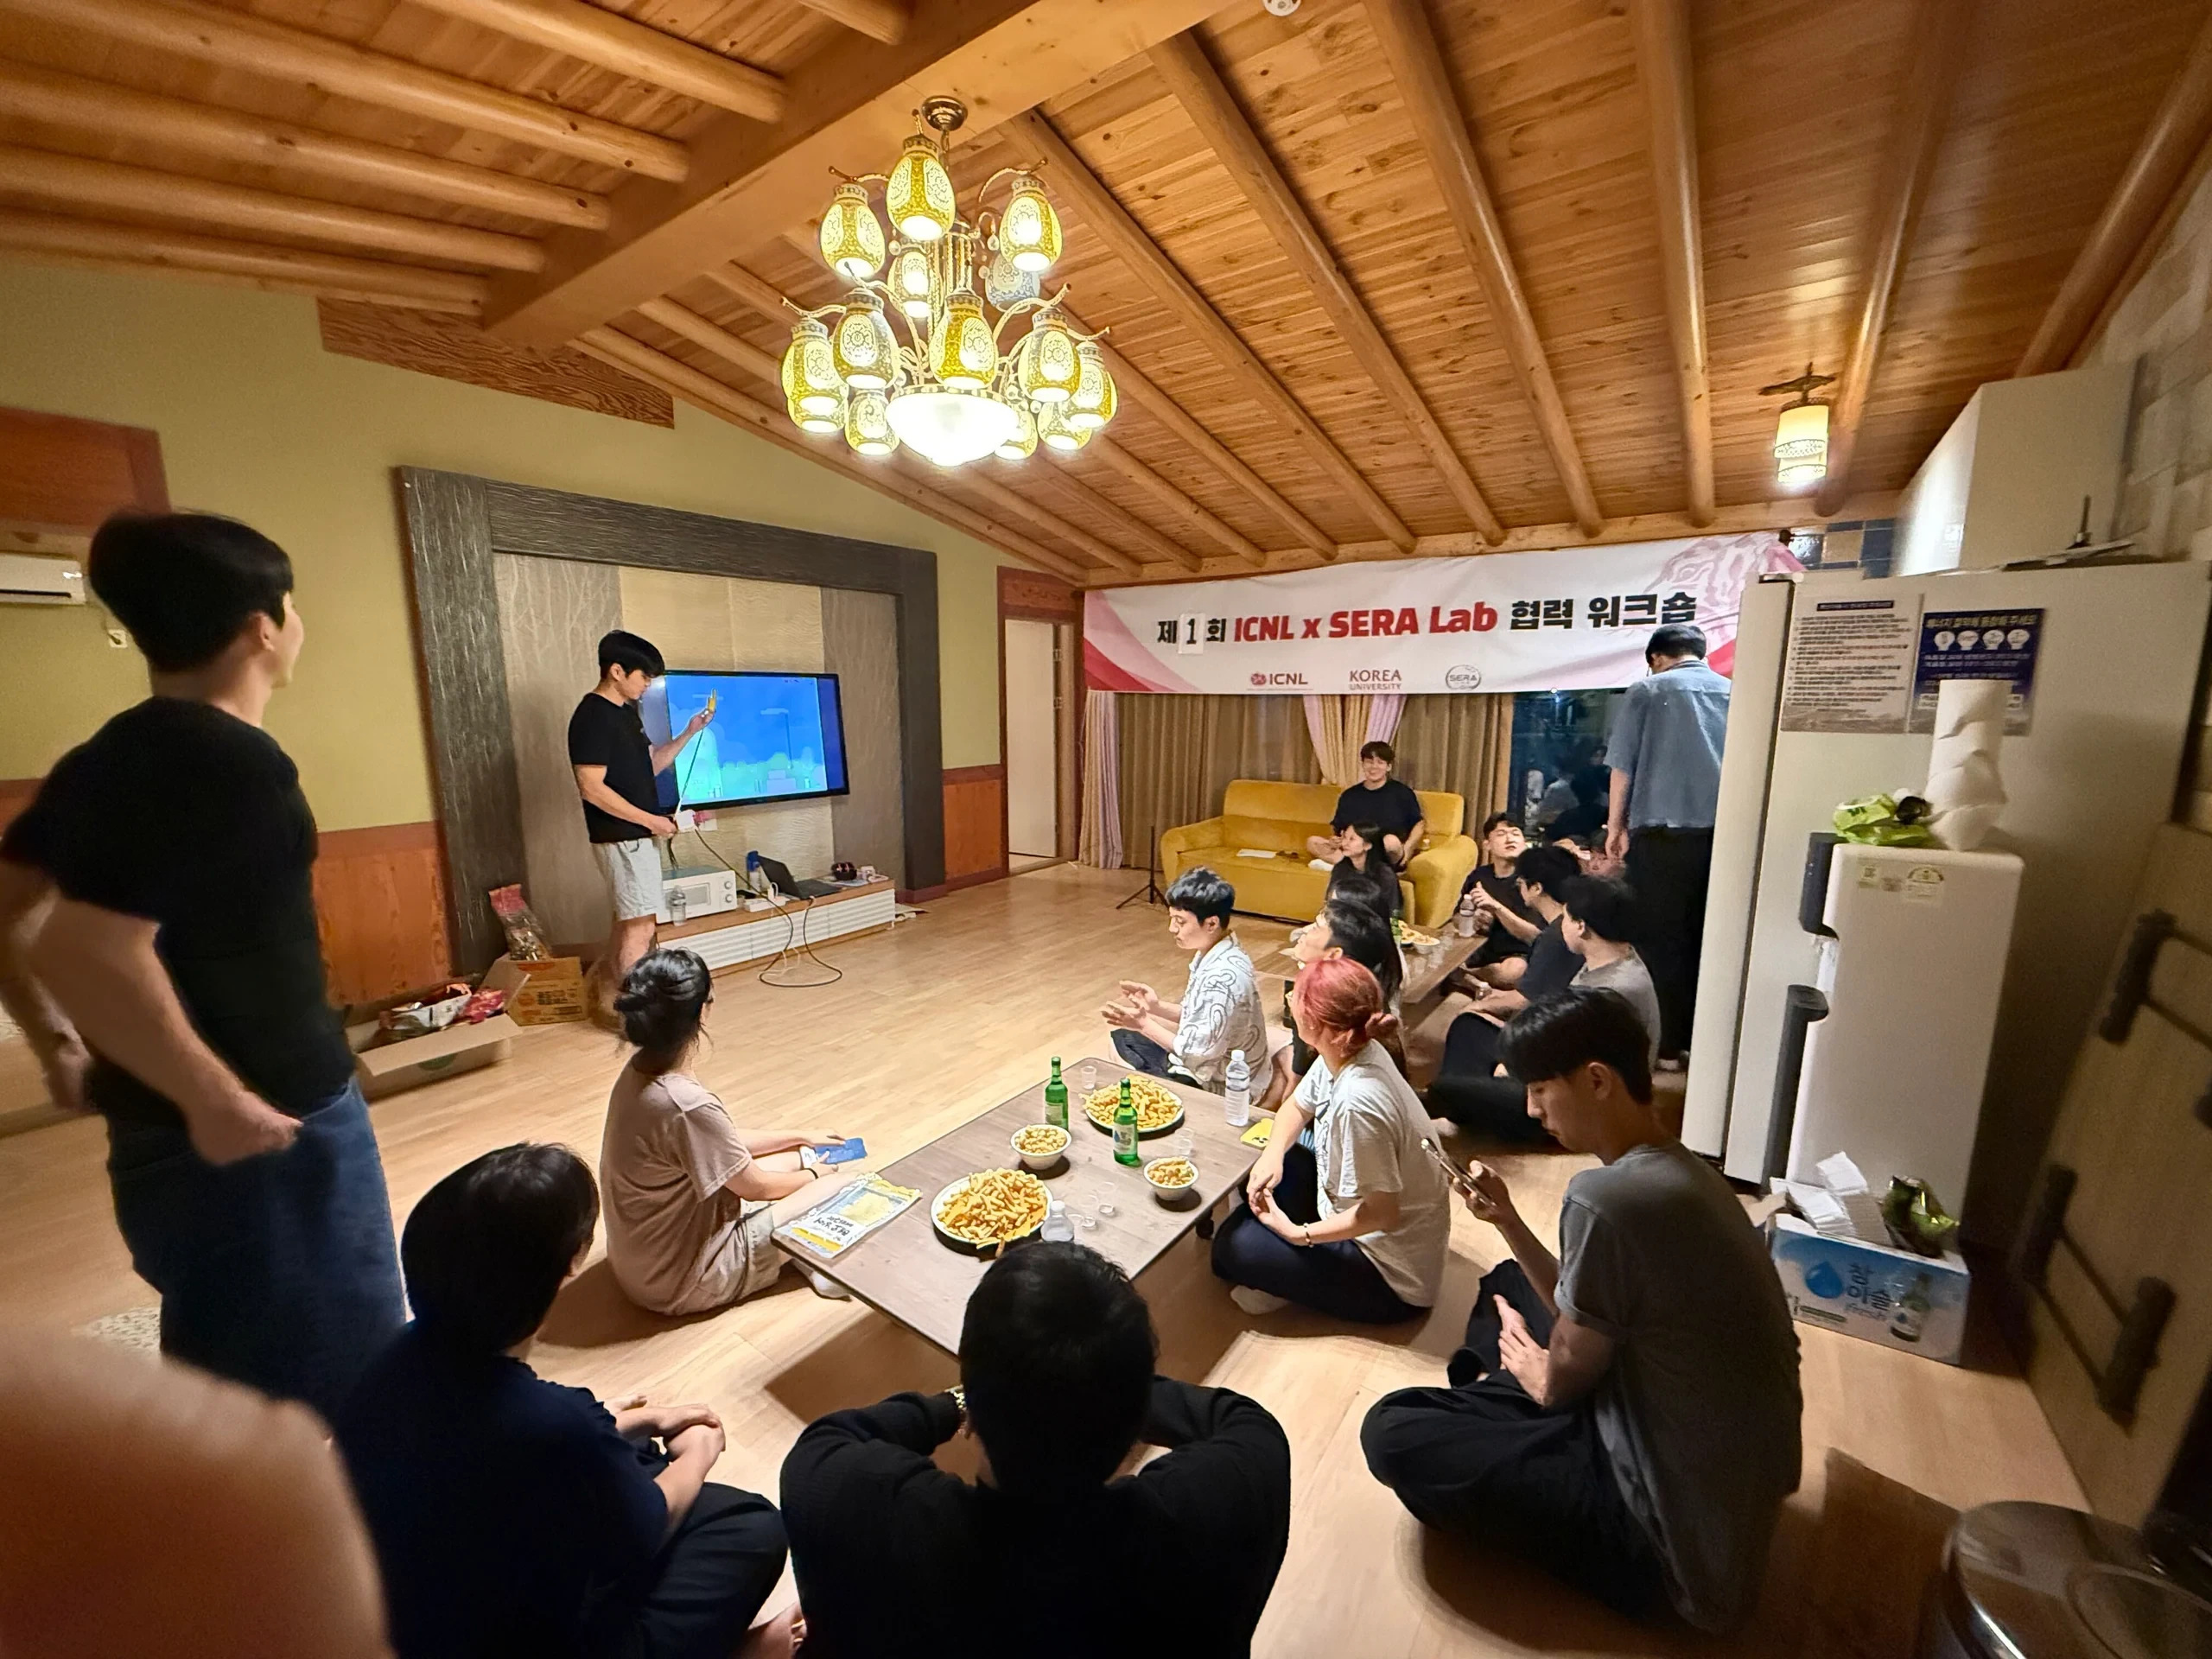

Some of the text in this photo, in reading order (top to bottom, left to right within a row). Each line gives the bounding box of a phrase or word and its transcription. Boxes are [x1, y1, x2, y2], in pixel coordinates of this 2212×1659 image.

[1157, 591, 1698, 645] 제 1 회 ICNL x SERA Lab 협력 워크숍
[1269, 673, 1308, 685] ICNL
[1350, 669, 1402, 683] KOREA
